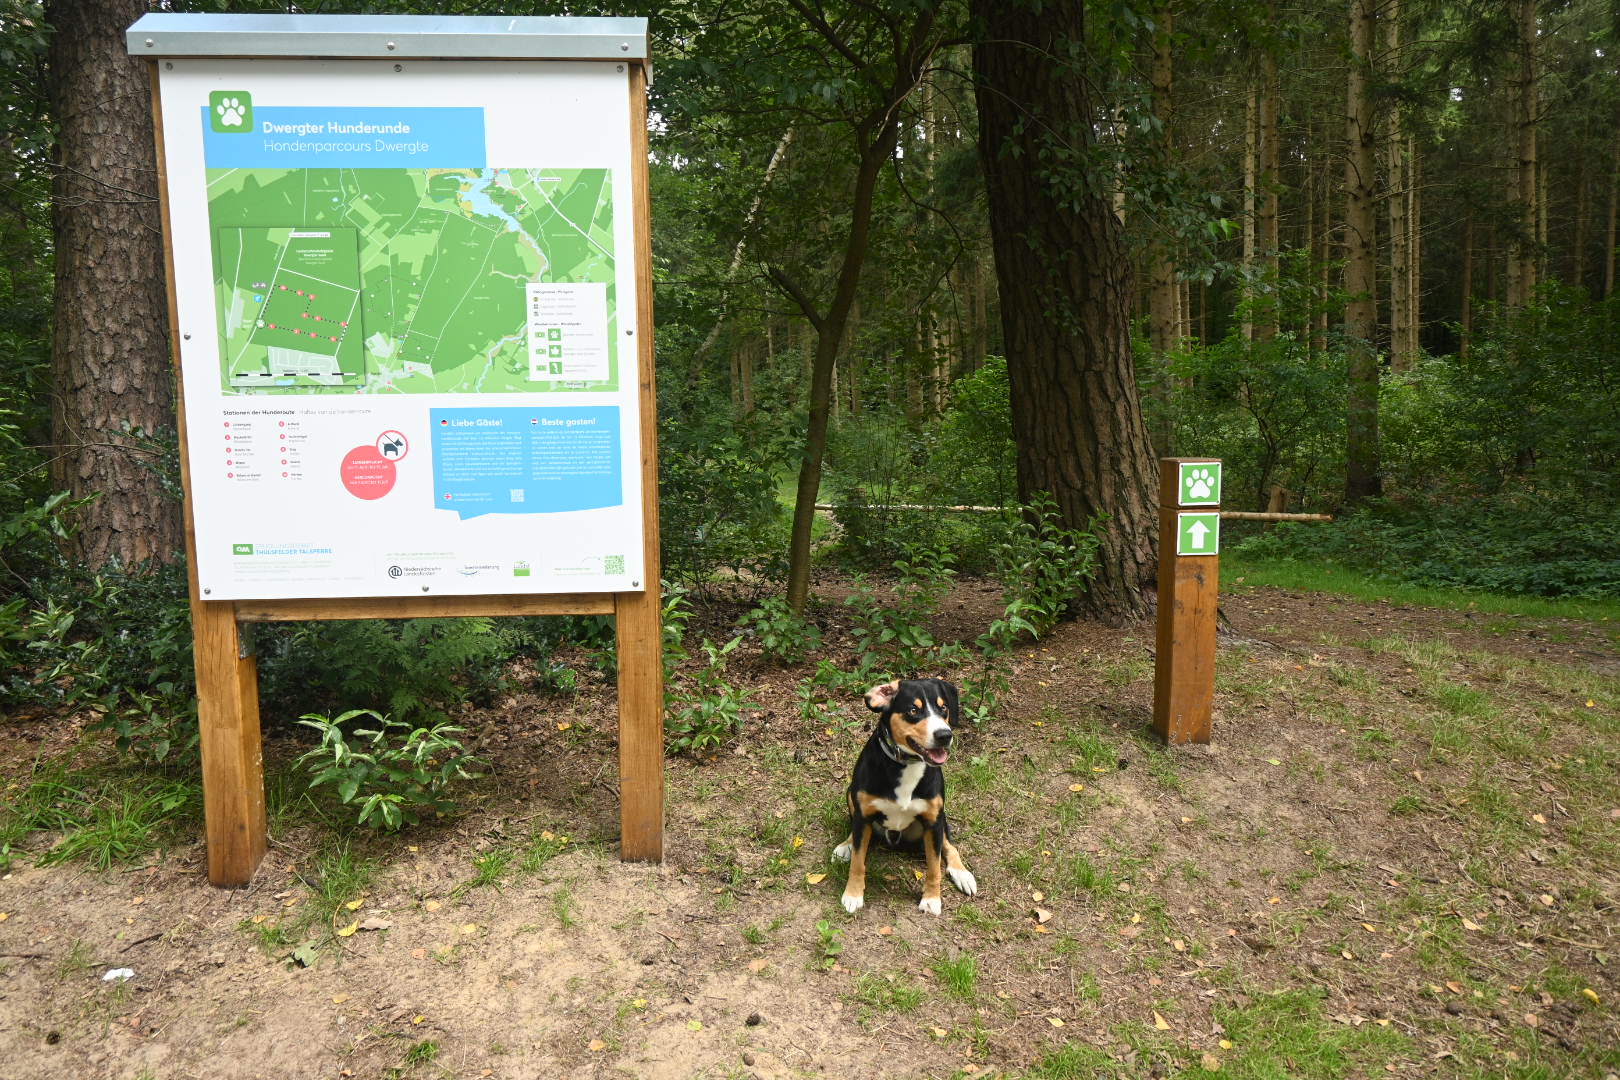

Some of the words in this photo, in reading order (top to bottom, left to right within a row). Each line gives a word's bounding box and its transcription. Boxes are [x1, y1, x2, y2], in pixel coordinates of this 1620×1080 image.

[263, 122, 323, 136] Dwergter
[328, 122, 410, 134] Hunderunde
[264, 140, 371, 154] Hondenparcours
[375, 139, 429, 155] Dwergte
[451, 419, 475, 427] Liebe
[541, 418, 564, 426] Beste
